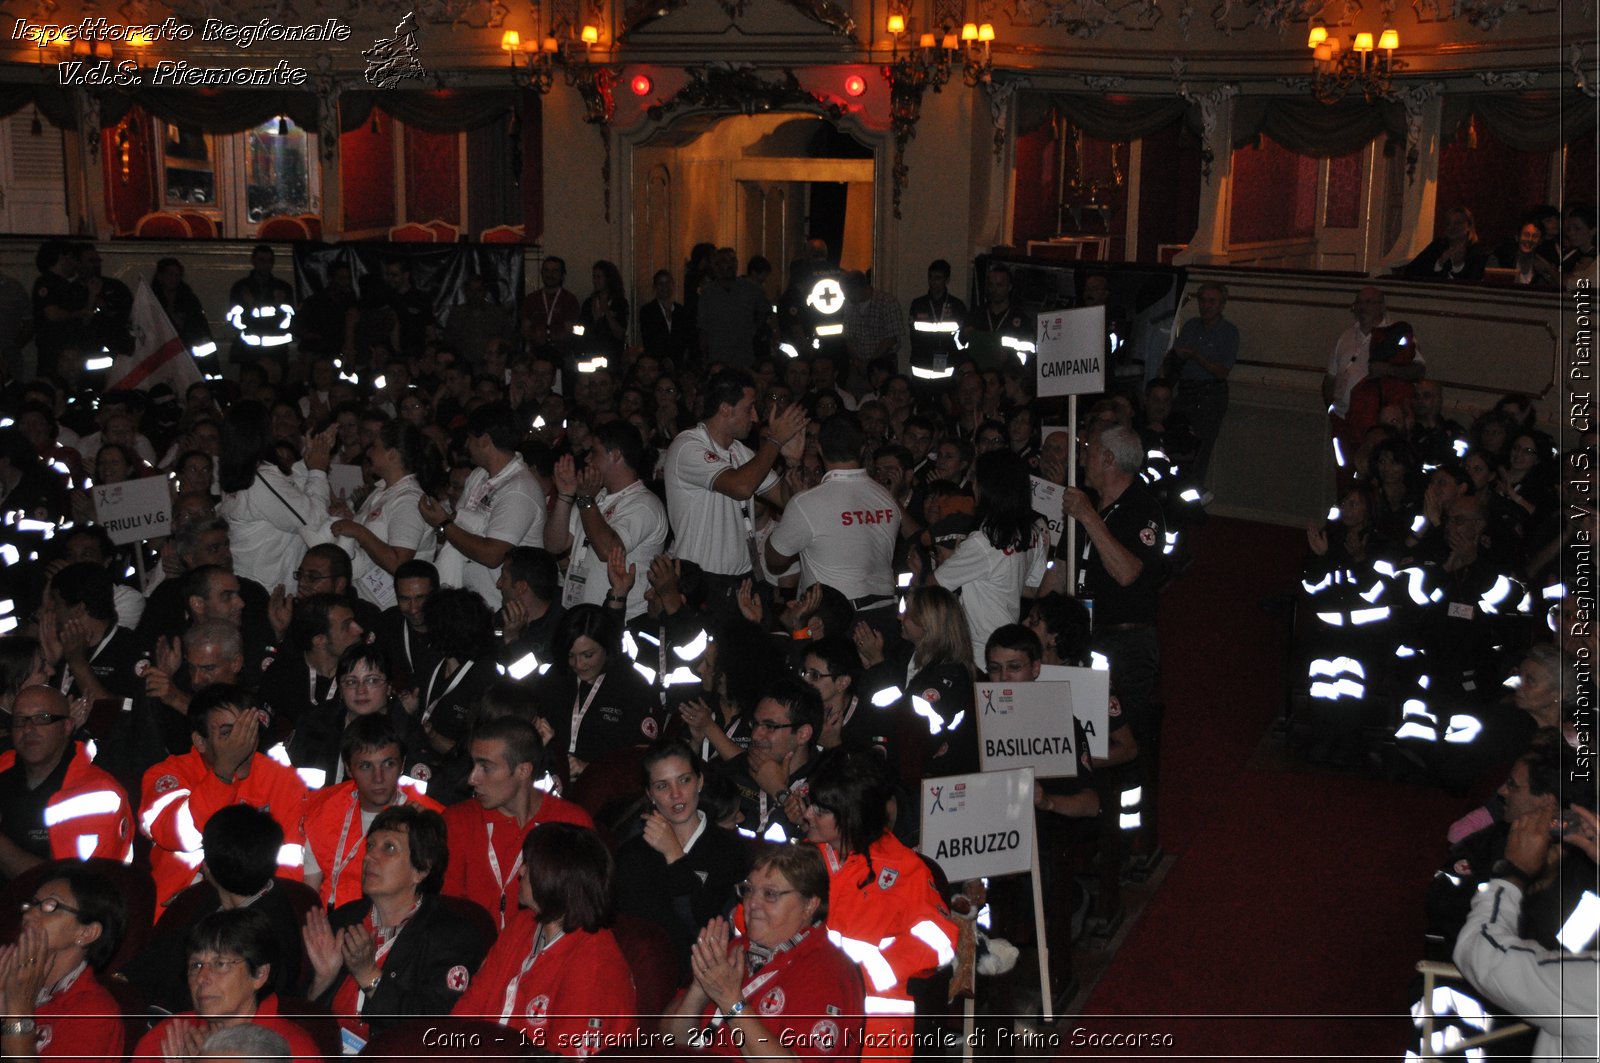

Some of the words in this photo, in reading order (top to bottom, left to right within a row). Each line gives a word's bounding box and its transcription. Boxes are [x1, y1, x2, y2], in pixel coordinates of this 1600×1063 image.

[1041, 357, 1100, 378] CAMPANIA
[103, 515, 142, 532] FRIULI
[143, 511, 169, 525] V.G.
[841, 509, 894, 526] STAFF
[985, 736, 1073, 757] BASILICATA
[935, 830, 1020, 859] ABRUZZO
